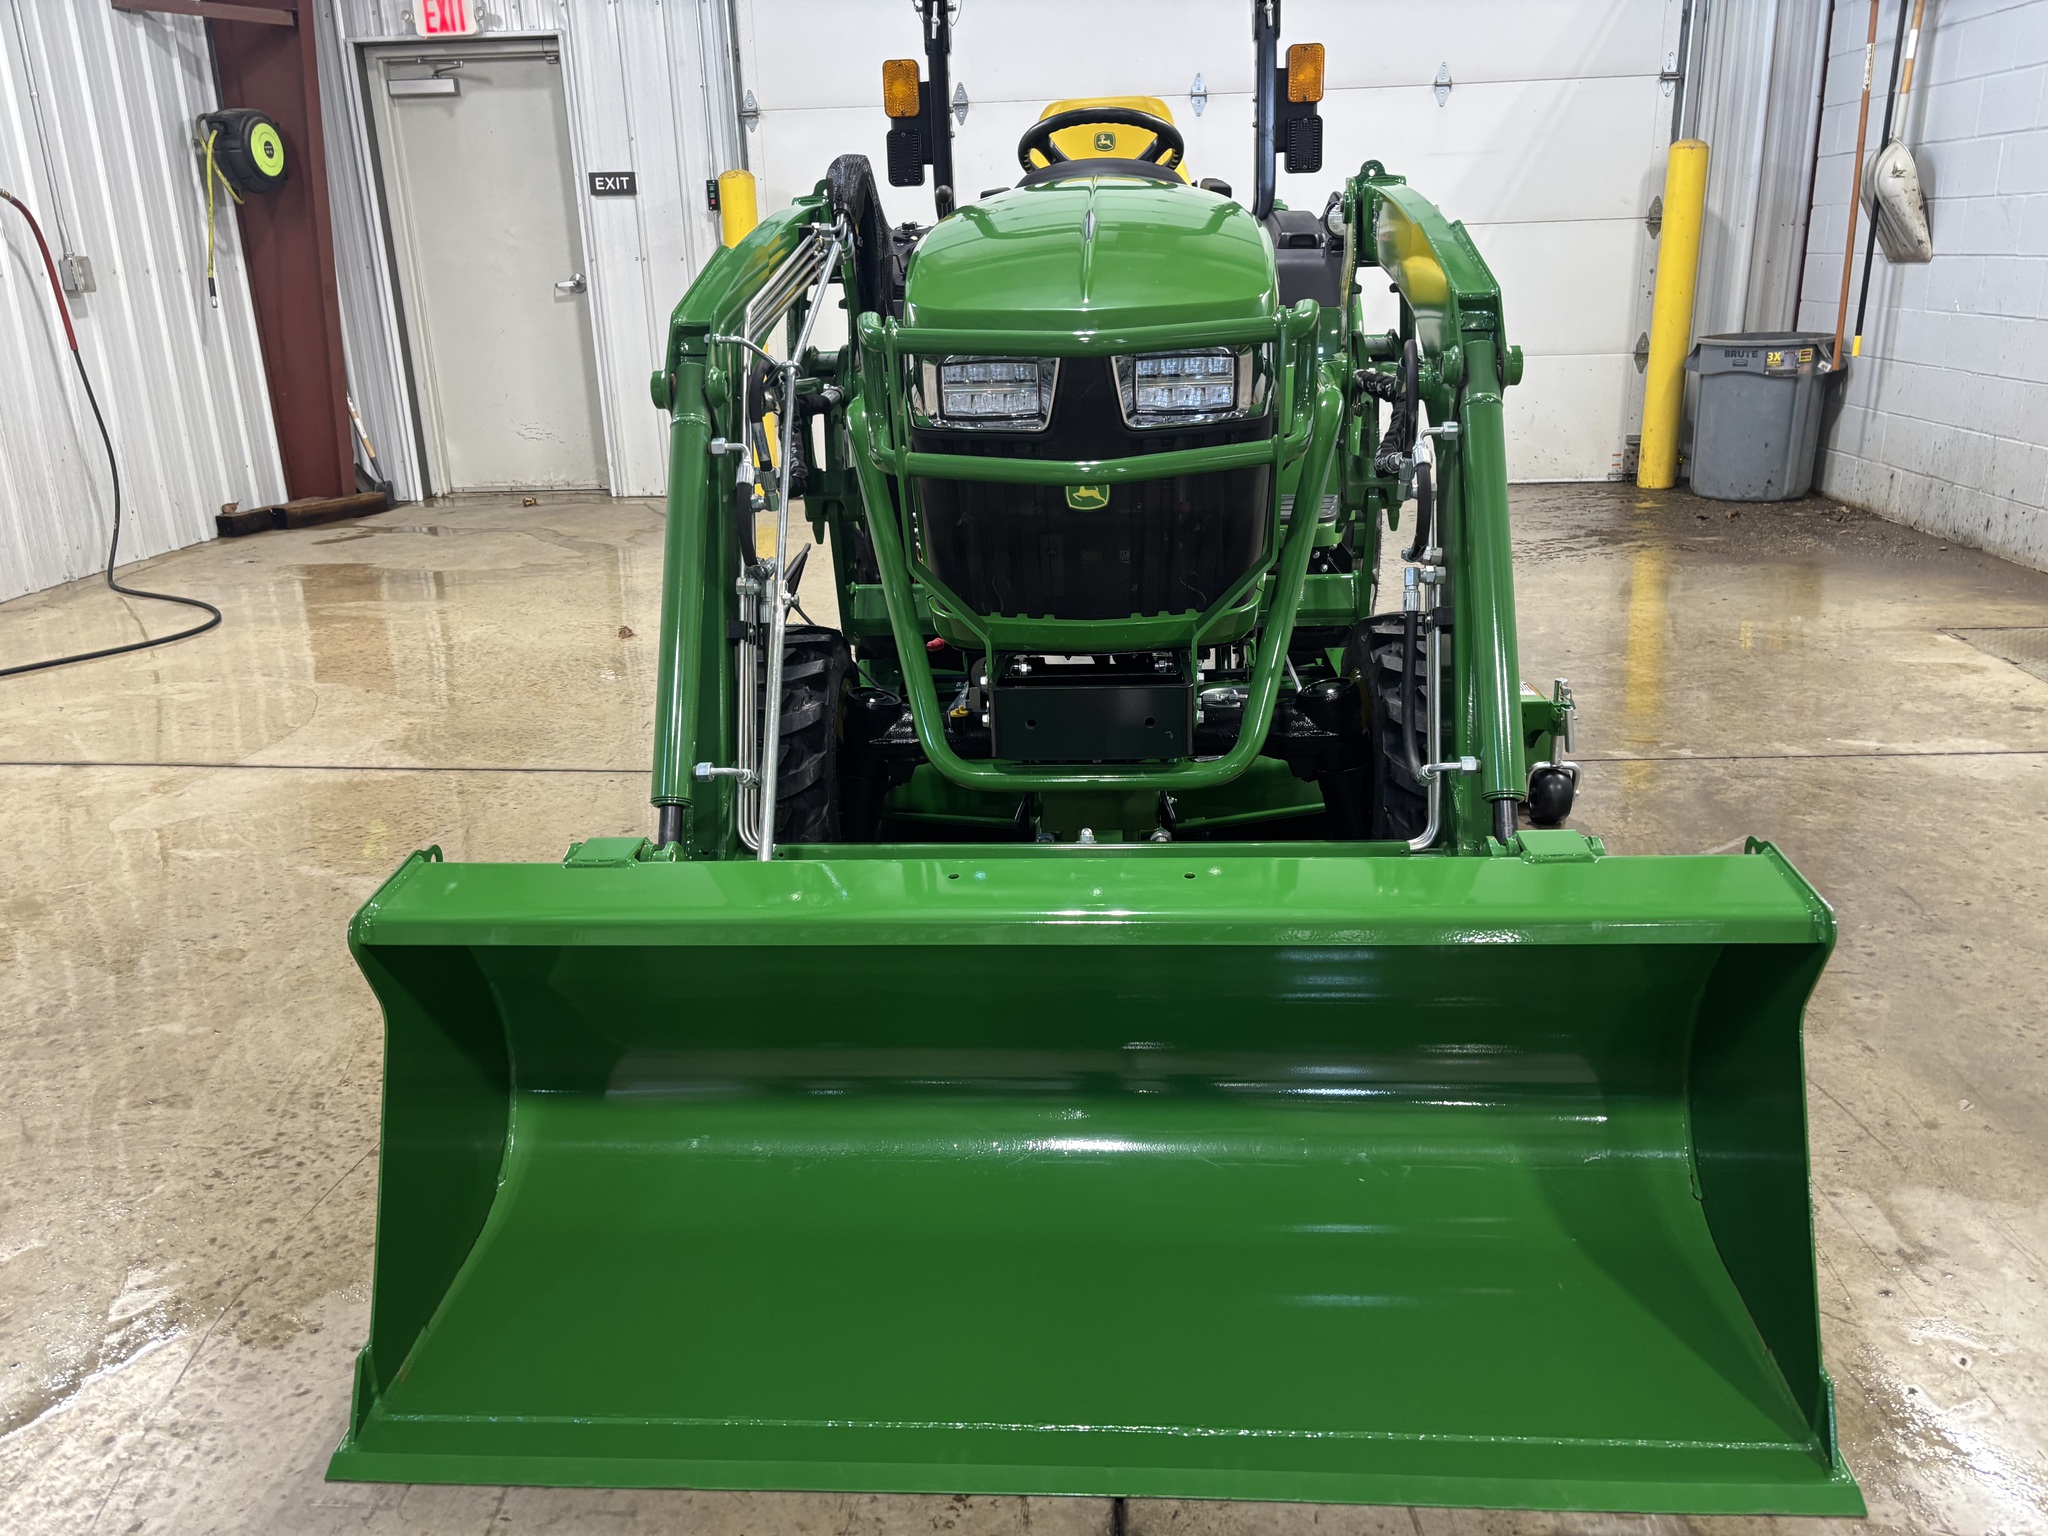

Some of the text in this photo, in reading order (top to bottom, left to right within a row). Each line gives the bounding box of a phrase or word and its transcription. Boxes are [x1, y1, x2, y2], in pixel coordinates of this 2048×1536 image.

[595, 177, 629, 190] EXIT
[1724, 350, 1758, 358] BRUTE
[1767, 352, 1781, 361] 3X
